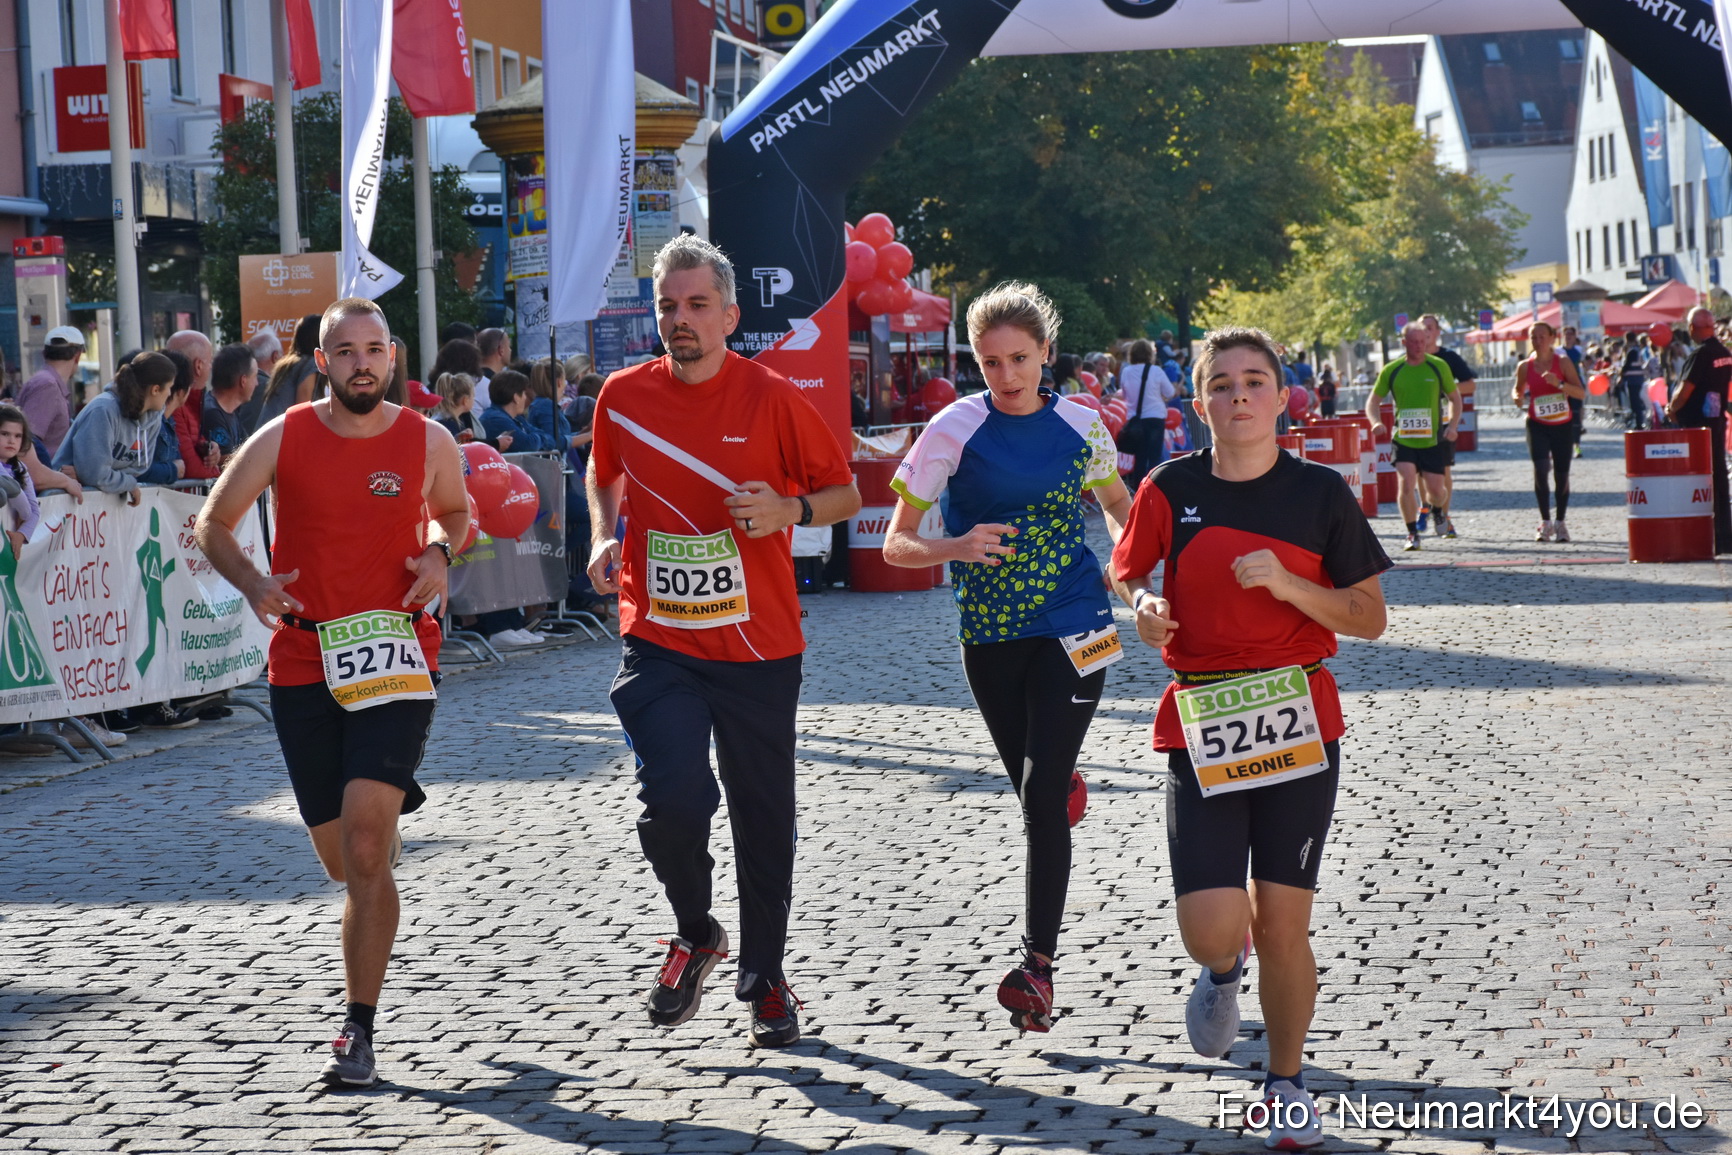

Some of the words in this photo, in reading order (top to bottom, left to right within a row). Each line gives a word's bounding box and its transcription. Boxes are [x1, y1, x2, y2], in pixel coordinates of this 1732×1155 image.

[749, 93, 824, 153] PARTL
[819, 9, 943, 105] NEUMARKT
[731, 342, 744, 351] 100
[745, 342, 775, 351] YEARS
[743, 332, 760, 341] THE
[761, 332, 785, 341] NEXT
[1539, 402, 1565, 415] 5138
[1402, 419, 1428, 428] 5139
[73, 511, 107, 549] UNS
[1180, 515, 1202, 523] erima
[653, 535, 732, 560] BOCK
[655, 566, 734, 597] 5028
[656, 600, 737, 615] MARK-ANDRE
[327, 614, 410, 645] BOCK
[336, 642, 417, 680] 5274
[1081, 639, 1111, 660] ANNA
[1188, 672, 1298, 719] BOCK
[1301, 705, 1308, 713] S
[1201, 707, 1304, 759] 5242
[1225, 752, 1297, 780] LEONIE
